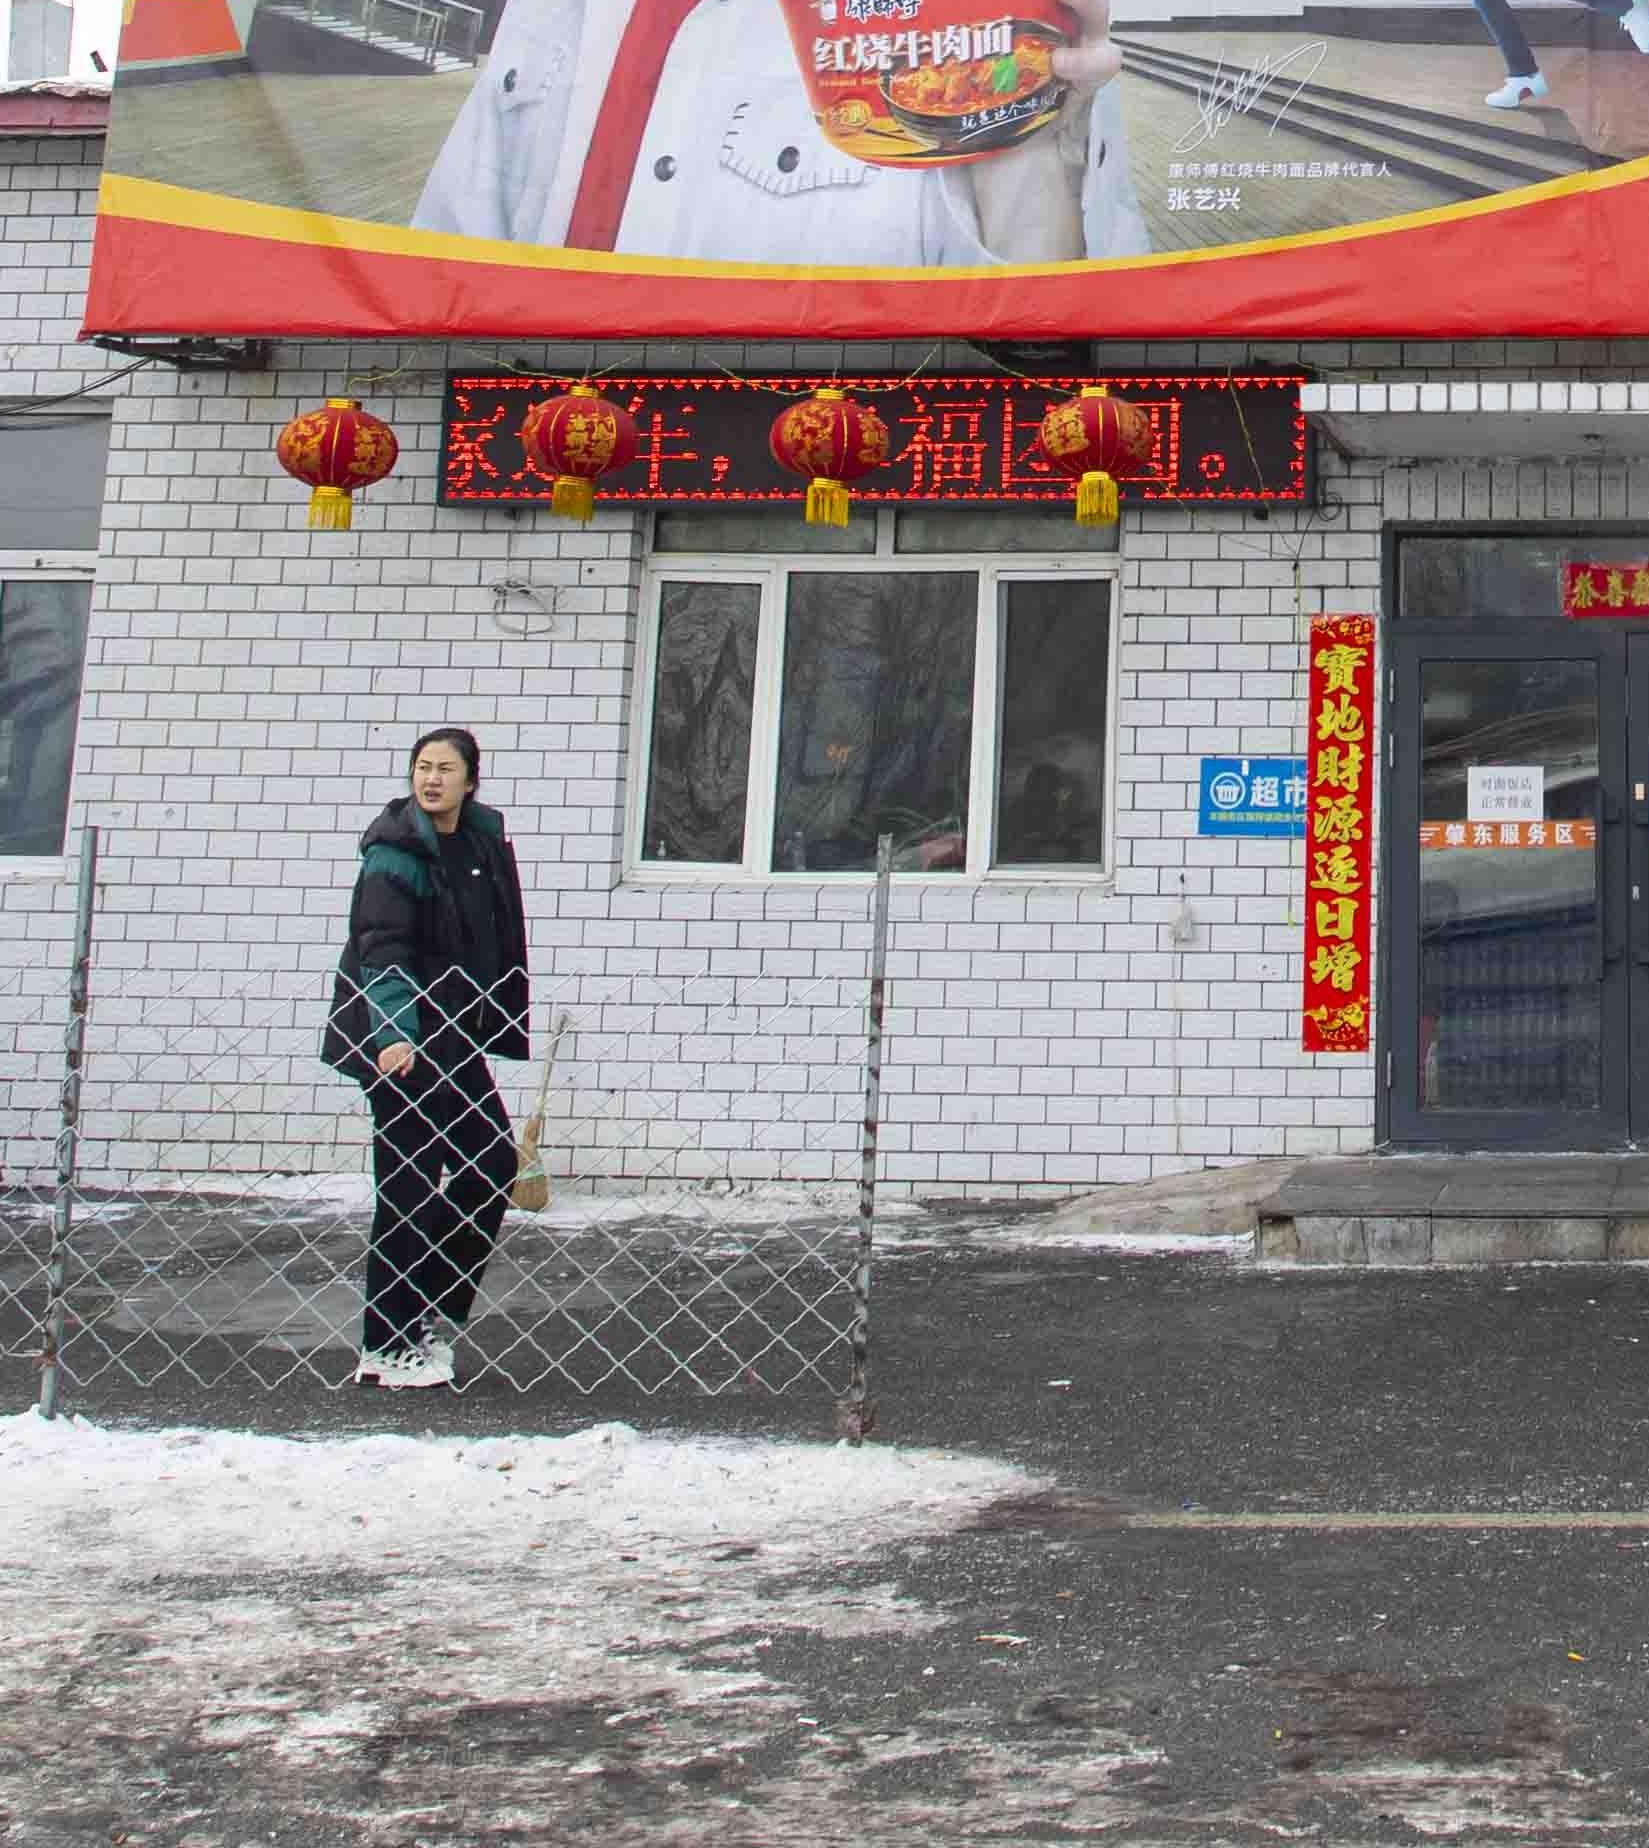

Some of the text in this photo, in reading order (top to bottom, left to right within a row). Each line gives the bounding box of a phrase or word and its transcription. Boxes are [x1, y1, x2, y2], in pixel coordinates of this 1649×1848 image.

[813, 16, 1014, 72] 红烧牛肉面
[1167, 186, 1241, 212] 张艺兴
[1309, 642, 1366, 994] 寶地財源逐日增
[1445, 823, 1574, 845] 肇东服务区
